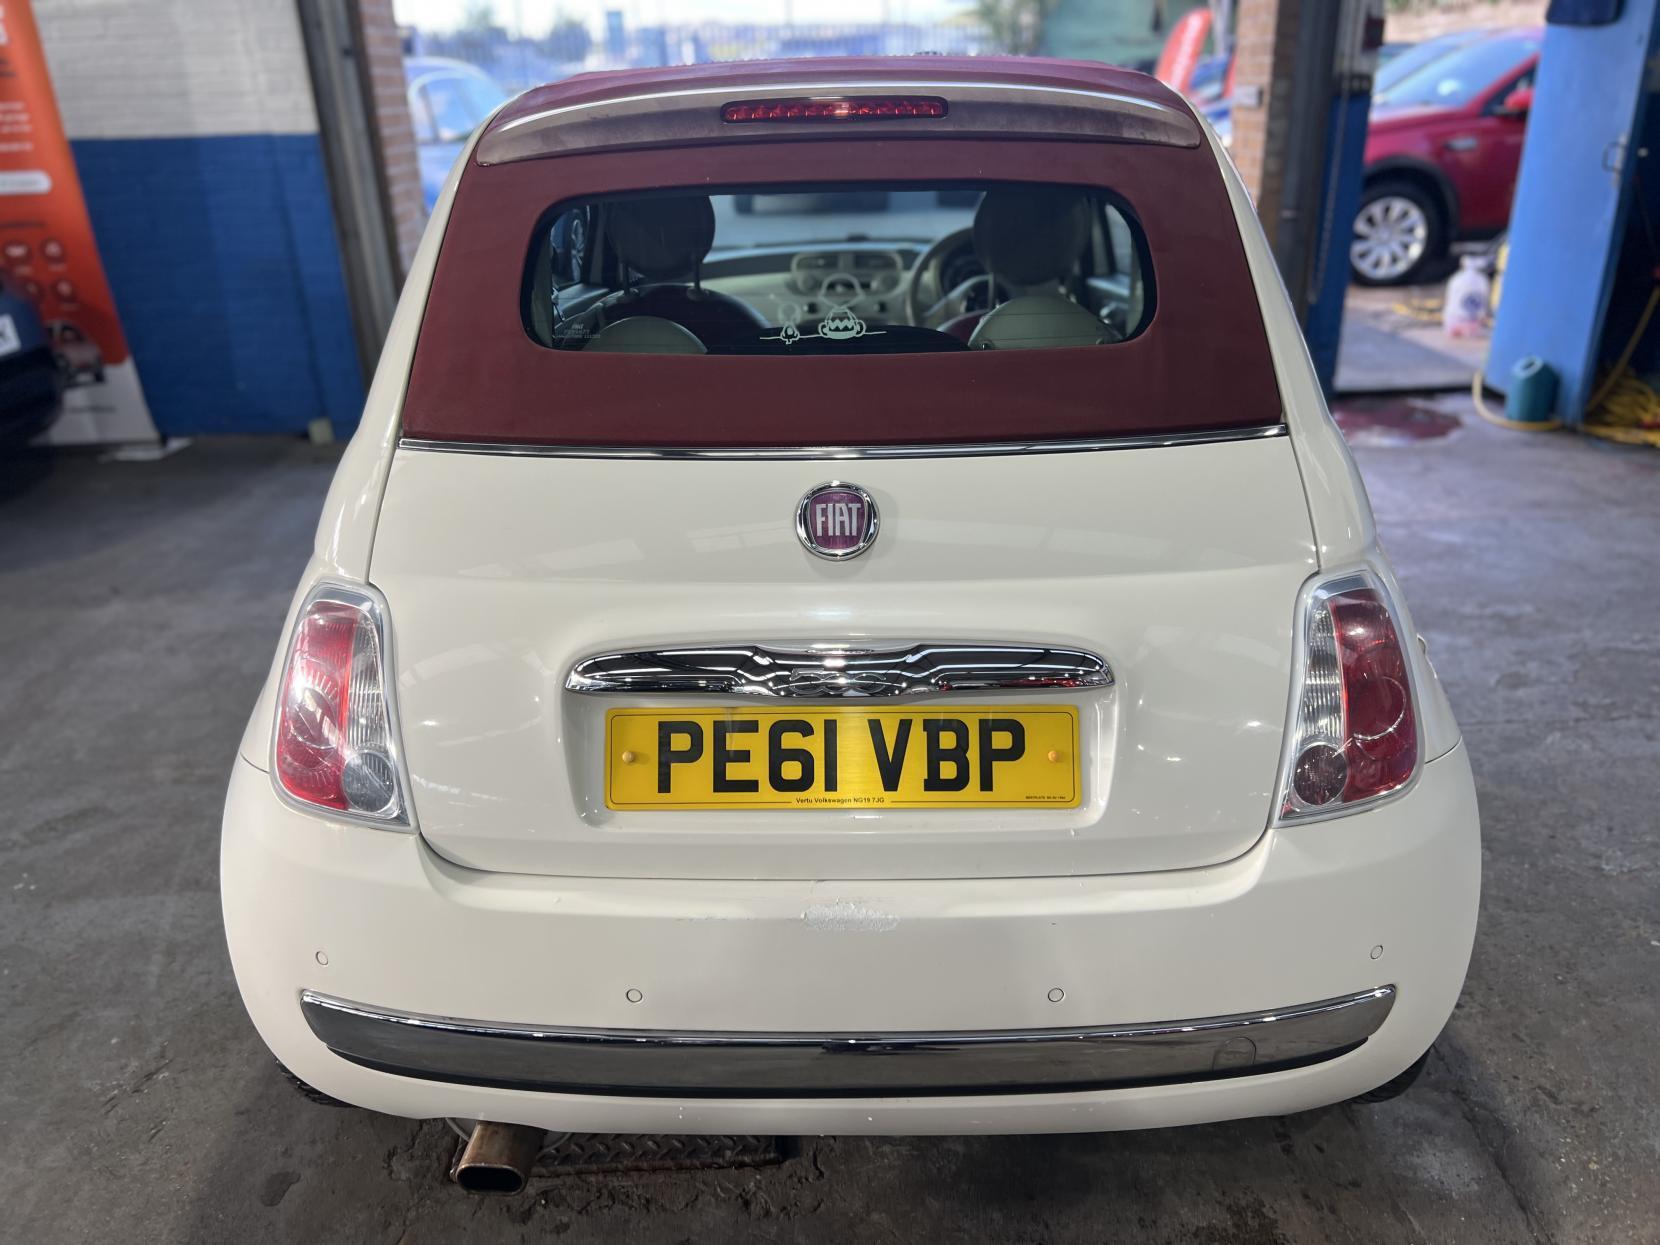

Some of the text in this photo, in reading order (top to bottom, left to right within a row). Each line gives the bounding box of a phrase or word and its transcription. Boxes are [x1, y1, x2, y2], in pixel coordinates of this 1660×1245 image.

[815, 503, 861, 536] FIAT
[657, 718, 1026, 793] PE61 VBP
[814, 797, 852, 805] Volkswagen
